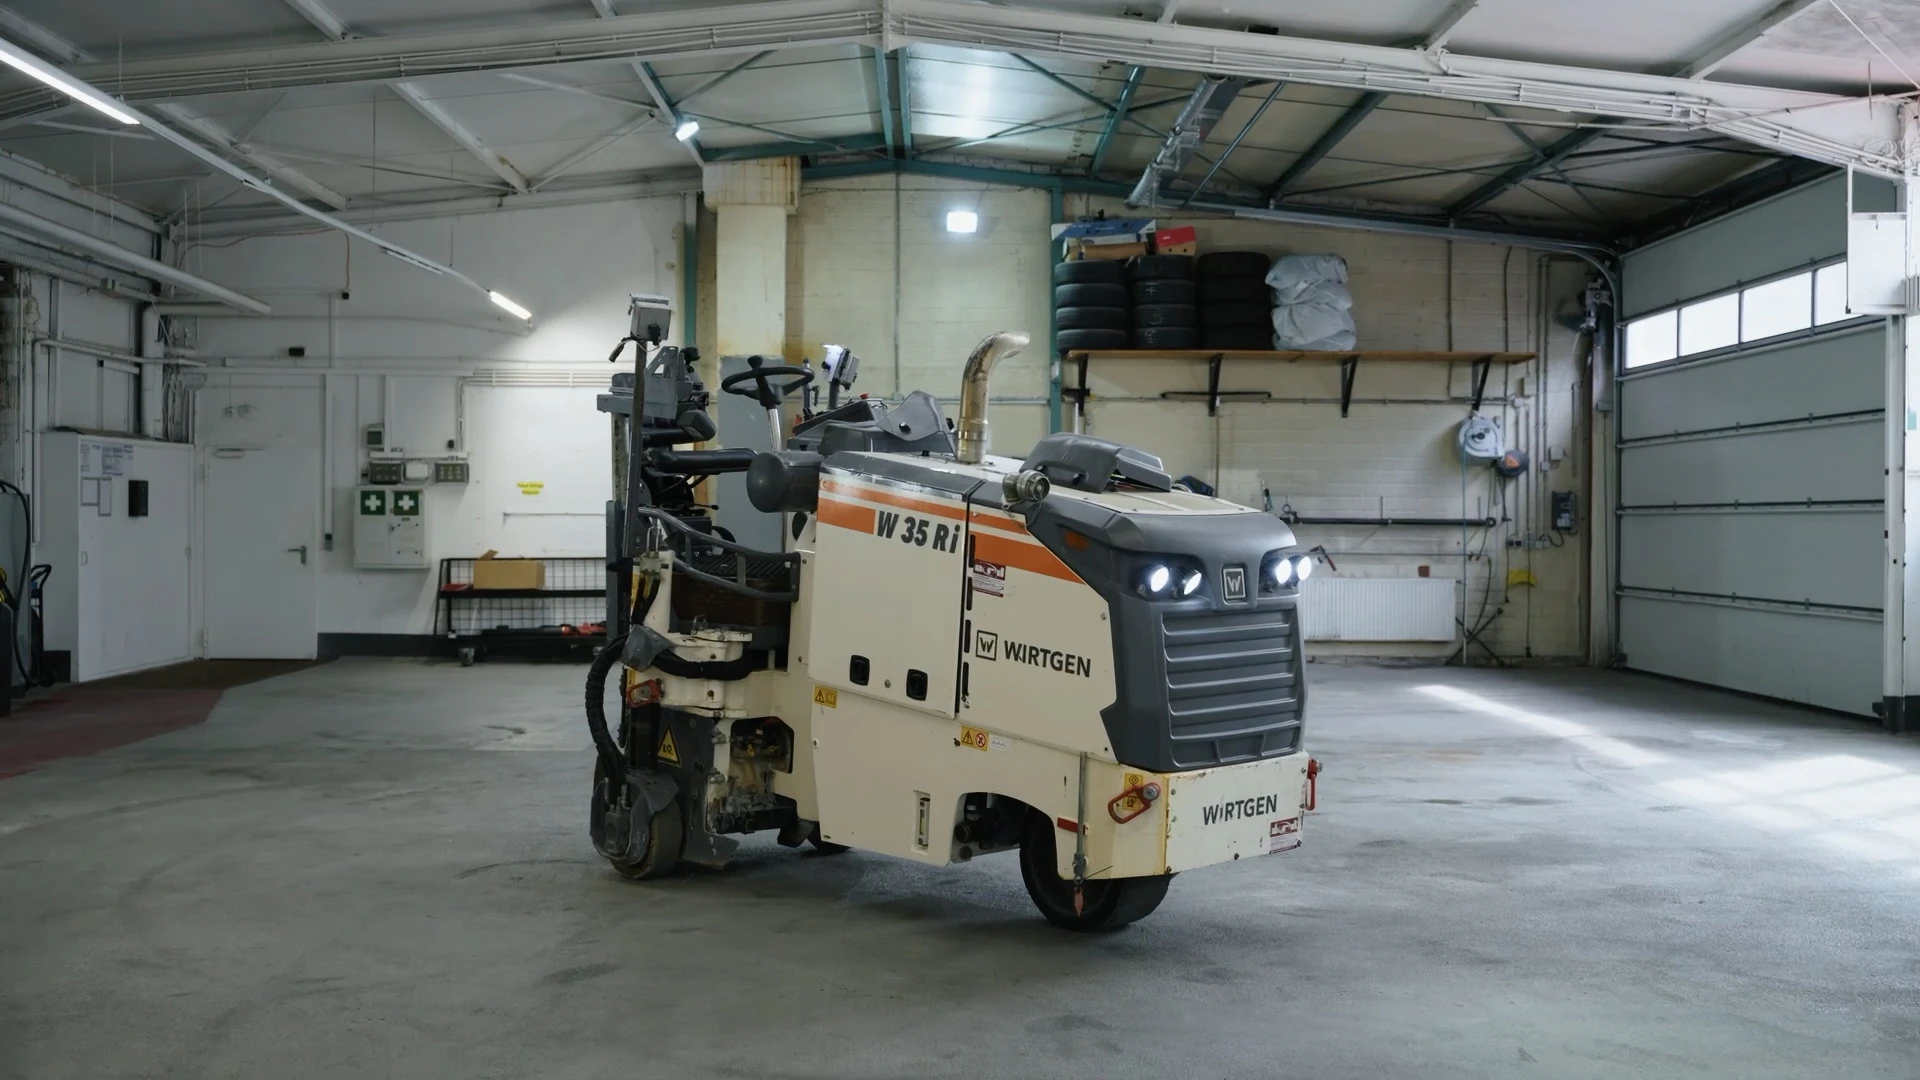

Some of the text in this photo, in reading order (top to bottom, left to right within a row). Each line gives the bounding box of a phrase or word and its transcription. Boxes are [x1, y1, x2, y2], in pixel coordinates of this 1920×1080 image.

[877, 510, 961, 554] W 35 Ri
[1004, 640, 1091, 678] WIRTGEN
[1203, 794, 1277, 826] WIRTGEN
